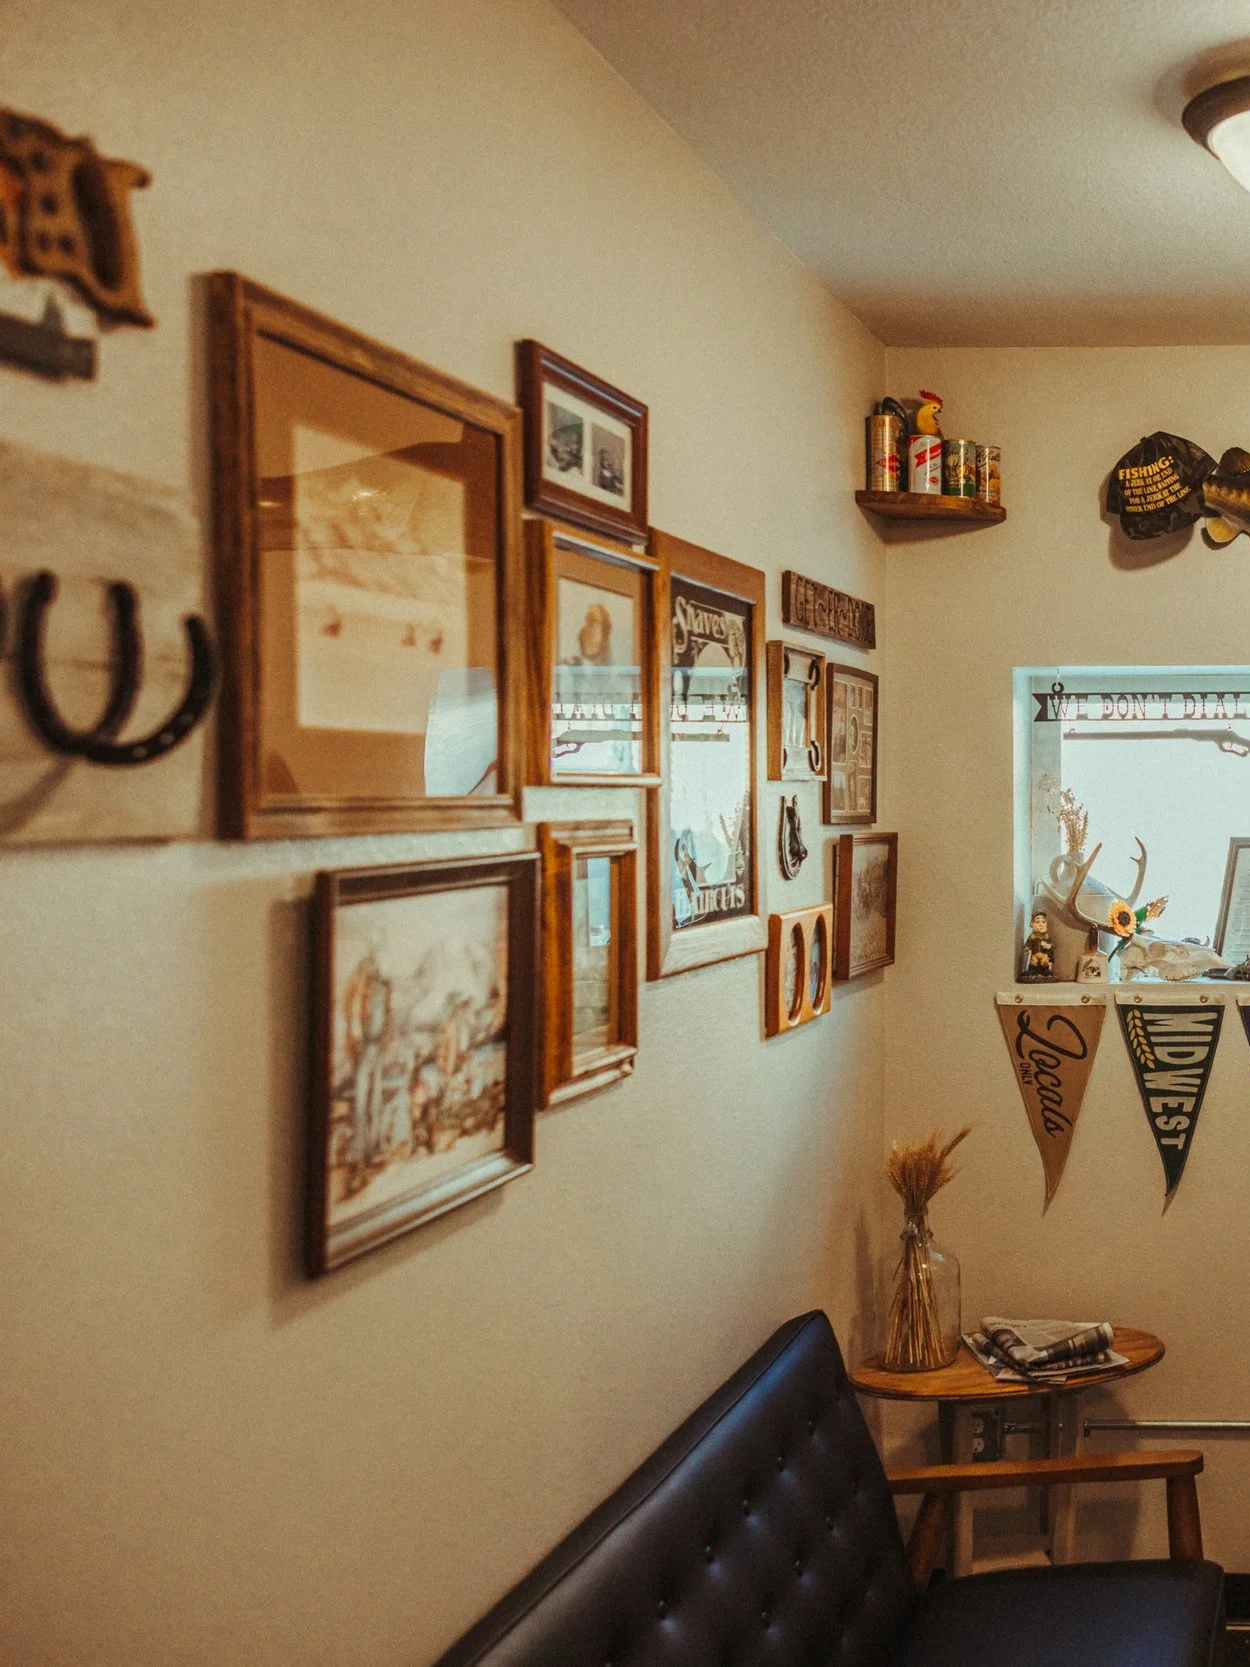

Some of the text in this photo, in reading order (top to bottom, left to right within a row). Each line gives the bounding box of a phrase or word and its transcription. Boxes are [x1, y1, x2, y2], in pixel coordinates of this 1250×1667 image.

[1119, 456, 1174, 480] FISHING:
[1131, 479, 1145, 487] JERK
[1146, 477, 1153, 485] AT
[1161, 467, 1173, 478] END
[1144, 485, 1159, 494] LINE
[1157, 473, 1180, 489] WAITING
[1146, 492, 1162, 502] JERK
[1169, 482, 1182, 493] THE
[1143, 503, 1156, 511] END
[1165, 494, 1178, 505] THE
[1048, 693, 1088, 720] WE
[1101, 692, 1172, 720] DON'T
[1182, 692, 1247, 720] DIAL
[1015, 1009, 1088, 1139] Locals
[1020, 1062, 1033, 1086] ONLY
[1142, 1012, 1218, 1150] MIDWEST
